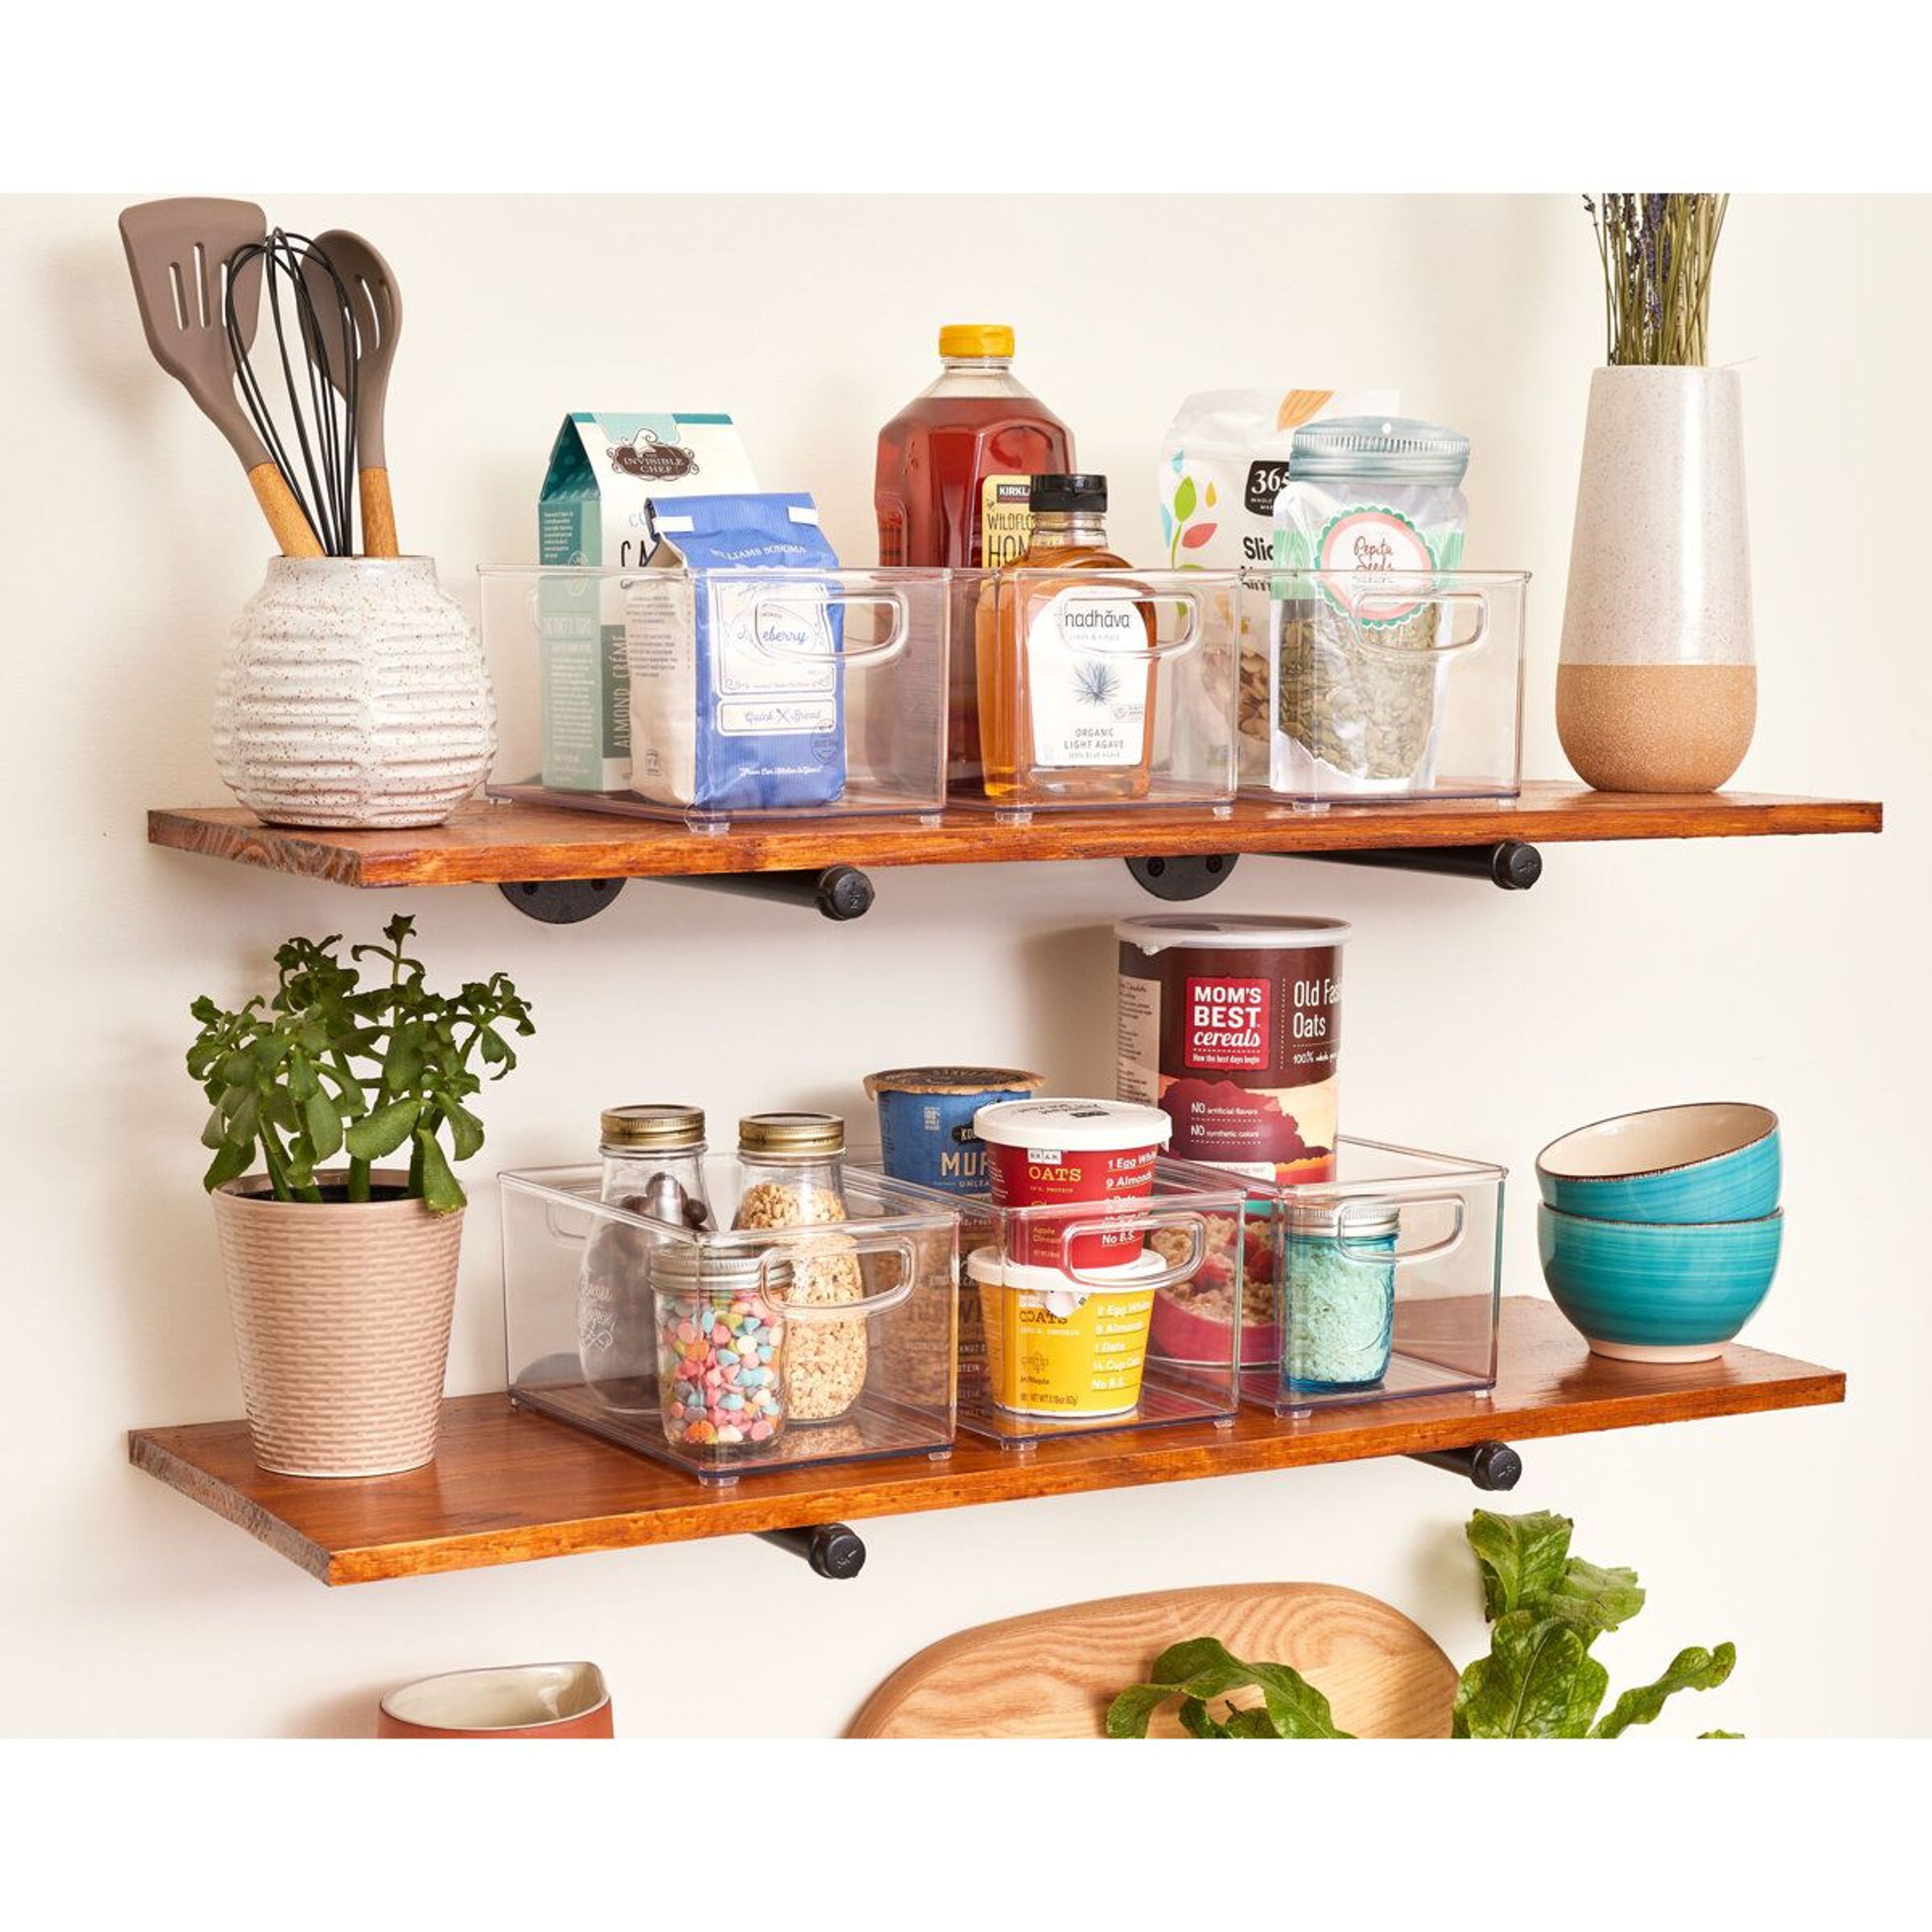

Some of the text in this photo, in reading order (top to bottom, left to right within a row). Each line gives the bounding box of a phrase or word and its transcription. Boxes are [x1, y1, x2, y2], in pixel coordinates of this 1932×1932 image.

[640, 465, 672, 473] CHEF
[1353, 535, 1393, 560] Pepita
[612, 687, 631, 748] ALMOND
[1075, 728, 1114, 738] ORGANIC
[1064, 740, 1124, 749] LIGHT AGAVE
[1194, 986, 1262, 1004] MOM'S
[1294, 981, 1320, 1007] Old
[1194, 1005, 1261, 1028] BEST
[1294, 1012, 1326, 1039] Oats
[1193, 1028, 1260, 1047] cereals
[1293, 1051, 1315, 1064] 100%
[1191, 1102, 1205, 1113] NO
[1190, 1124, 1205, 1136] NO
[1107, 1160, 1113, 1169] 1
[1117, 1158, 1136, 1170] Egg
[1028, 1166, 1081, 1182] OATS
[1107, 1178, 1113, 1187] 9
[1102, 1234, 1117, 1245] No
[1107, 1305, 1126, 1318] Egg
[1092, 1379, 1107, 1389] No
